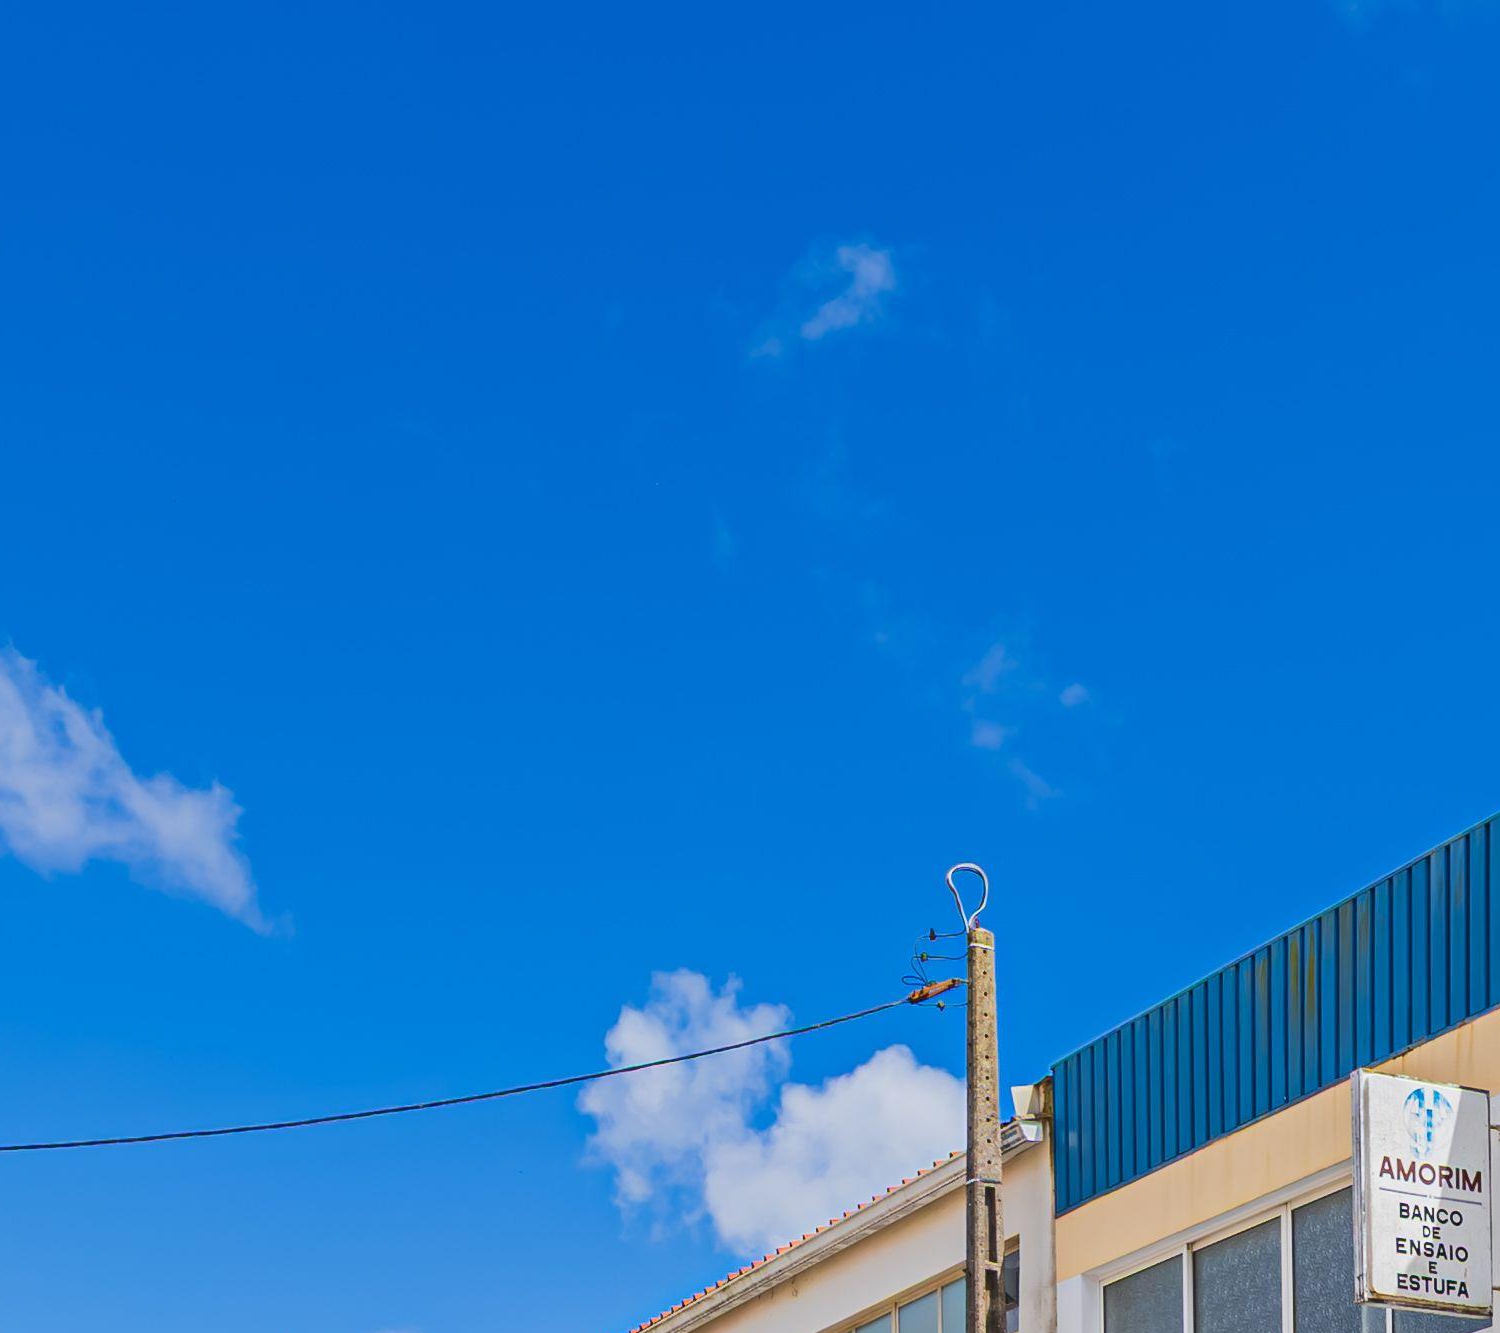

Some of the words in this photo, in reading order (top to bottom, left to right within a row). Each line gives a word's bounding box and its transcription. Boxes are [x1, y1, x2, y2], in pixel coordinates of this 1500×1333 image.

[1379, 1156, 1483, 1193] AMORIM
[1399, 1202, 1464, 1227] BANCO
[1422, 1226, 1441, 1240] DE
[1396, 1237, 1469, 1262] ENSAIO
[1429, 1261, 1438, 1274] E
[1396, 1273, 1469, 1299] ESTUFA
